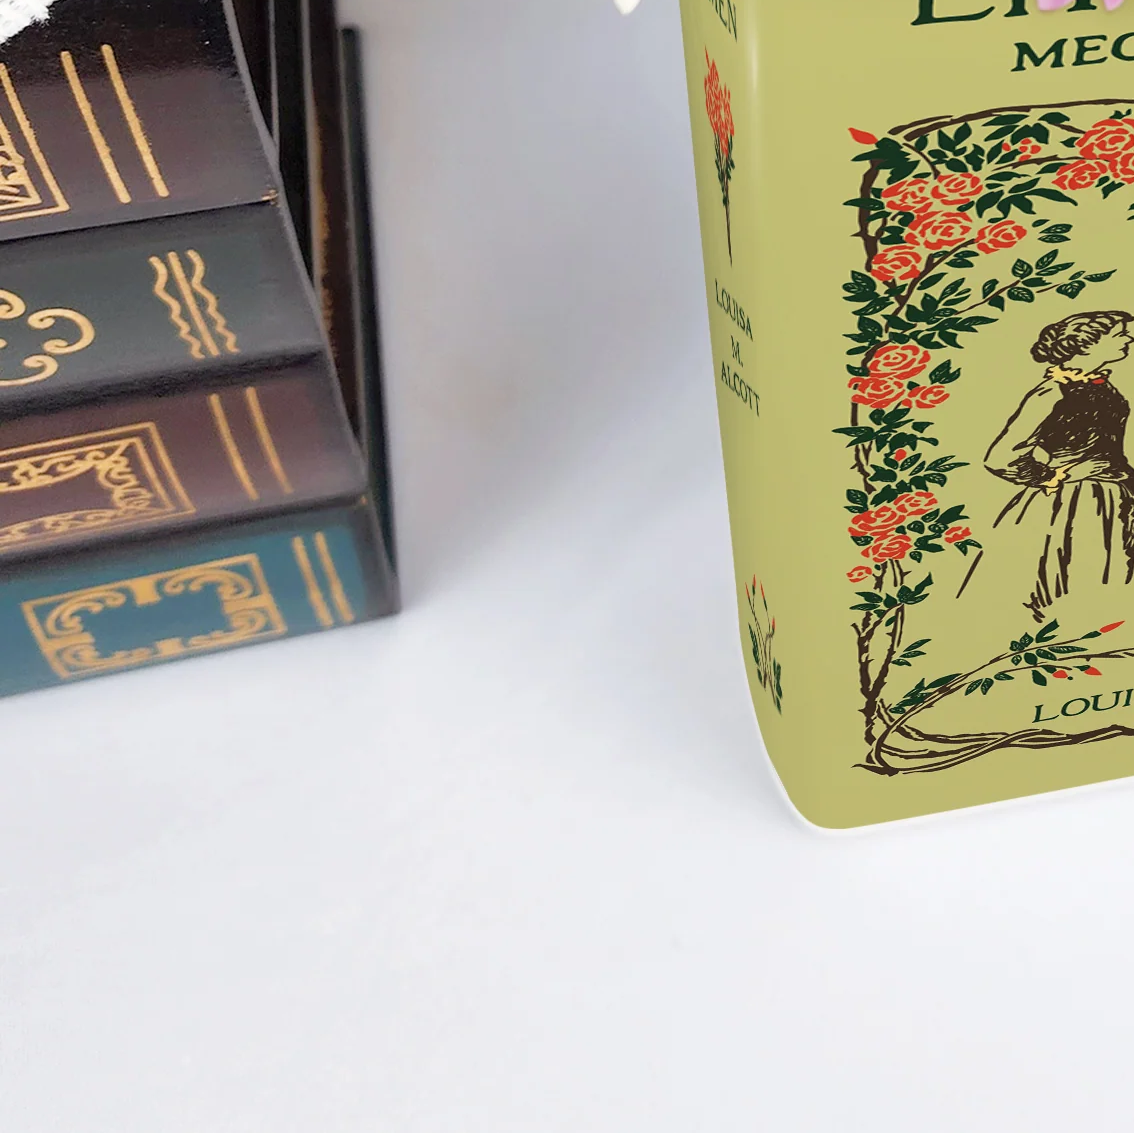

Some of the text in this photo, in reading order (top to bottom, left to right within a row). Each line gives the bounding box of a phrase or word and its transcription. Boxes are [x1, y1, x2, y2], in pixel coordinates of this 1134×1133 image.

[714, 277, 754, 343] LOUISA
[730, 334, 744, 368] M.
[720, 360, 761, 417] ALCOTT
